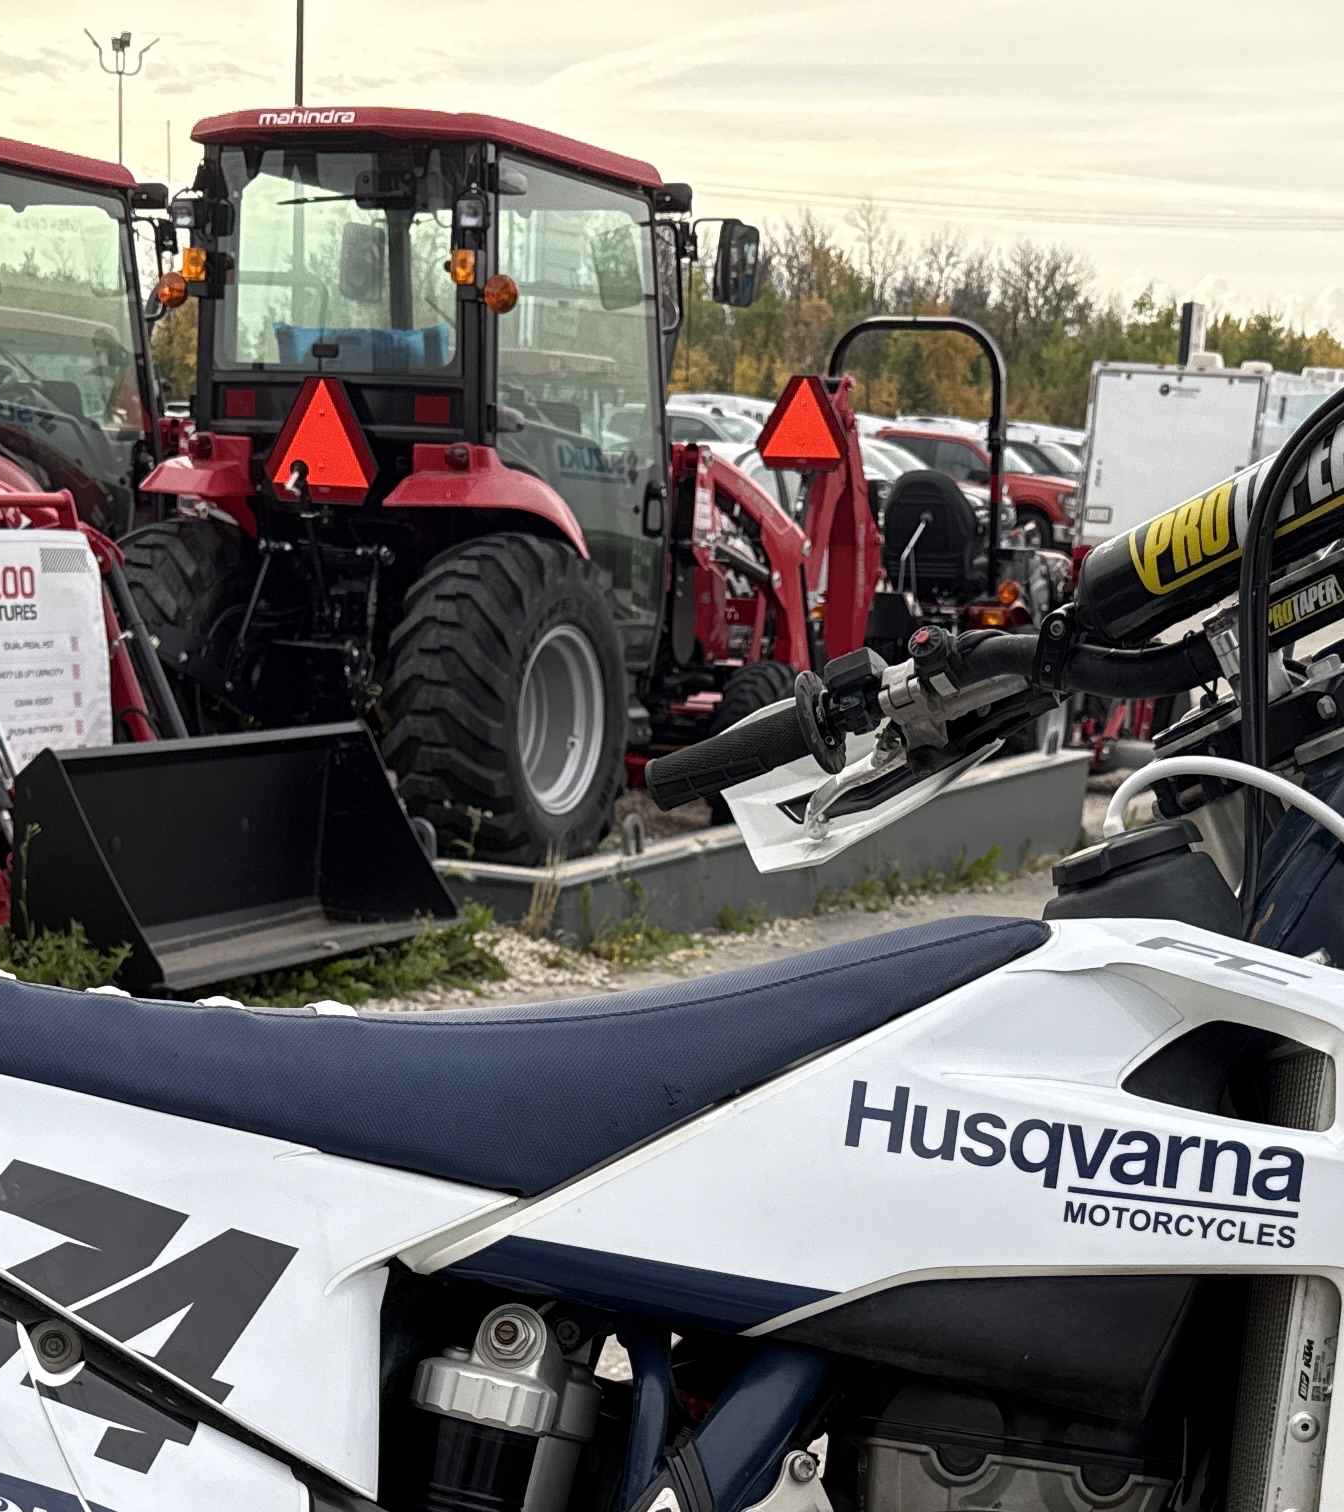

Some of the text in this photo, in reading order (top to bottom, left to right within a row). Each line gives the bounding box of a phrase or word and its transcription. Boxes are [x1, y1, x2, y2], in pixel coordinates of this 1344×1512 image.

[258, 110, 355, 125] mahindra
[1136, 936, 1313, 987] FC
[844, 1080, 1305, 1203] Husqvarna
[1063, 1201, 1297, 1249] MOTORCYCLES
[1302, 1338, 1314, 1369] KTM
